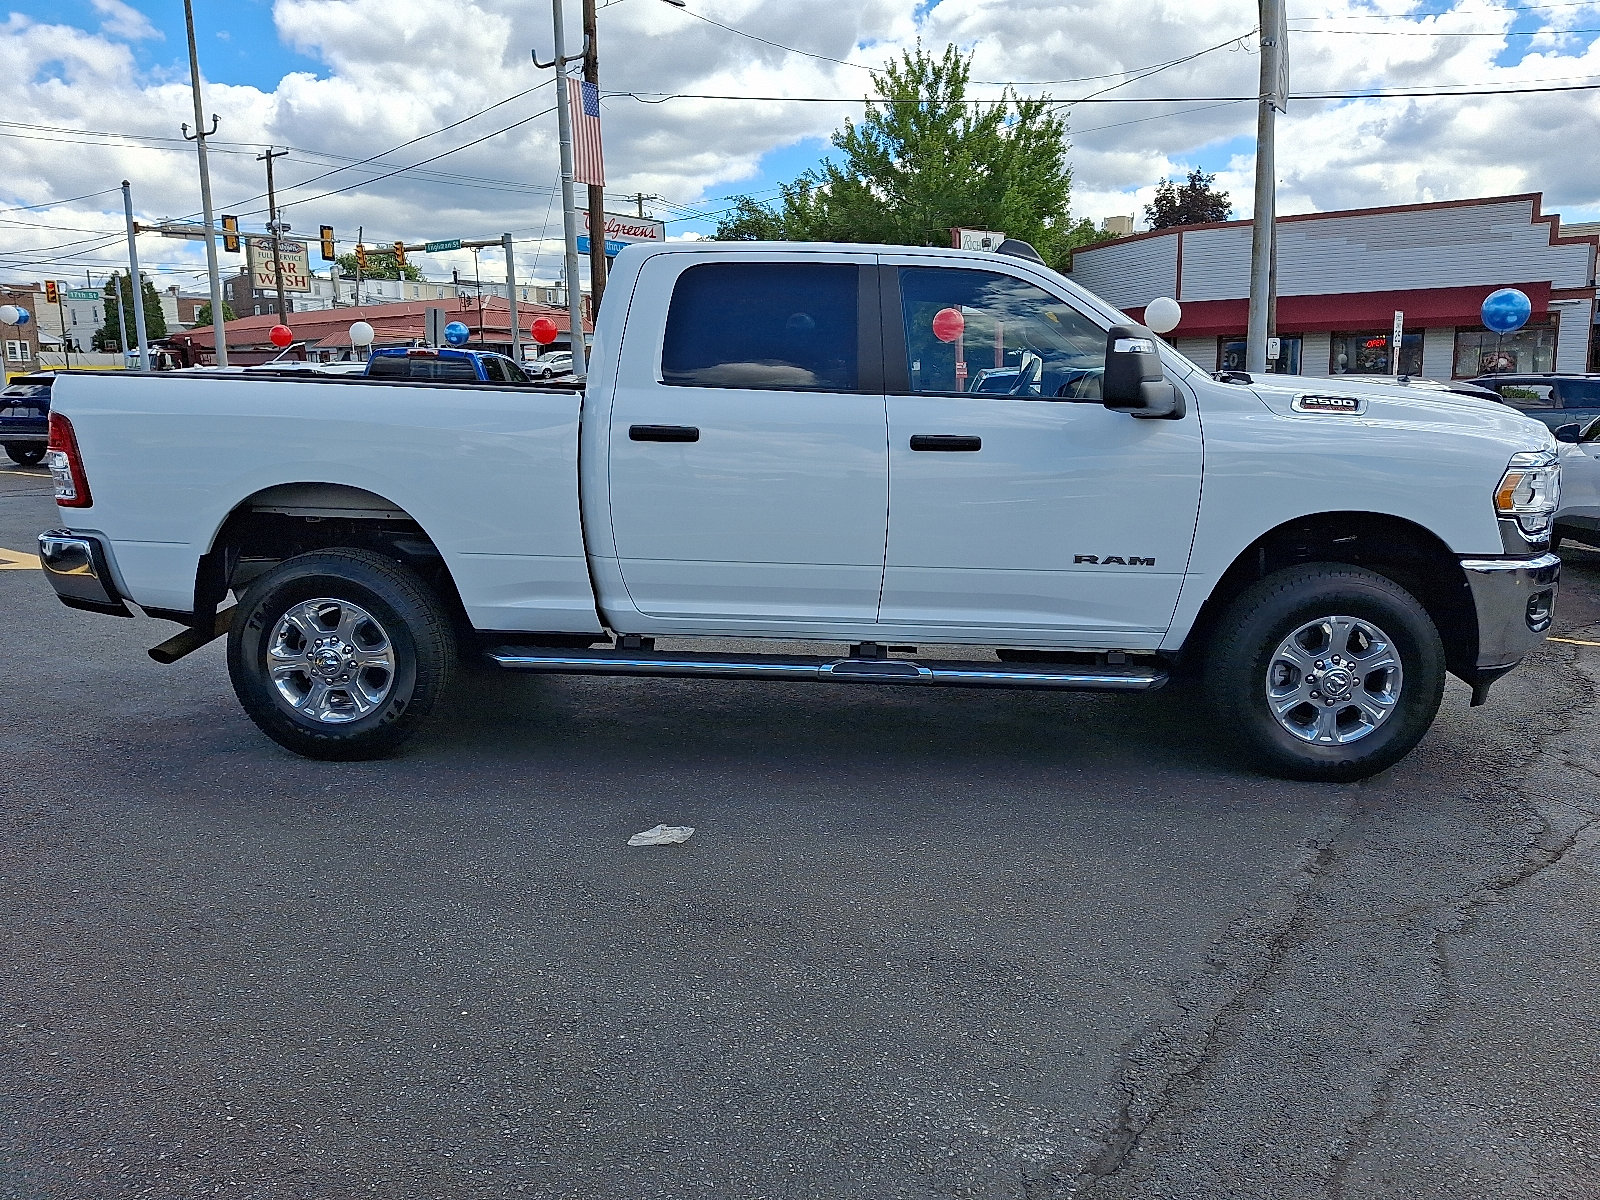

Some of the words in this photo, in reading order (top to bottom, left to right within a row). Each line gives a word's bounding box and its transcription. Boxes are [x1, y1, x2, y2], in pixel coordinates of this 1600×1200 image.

[279, 253, 302, 262] ERVICE
[258, 273, 306, 287] WSH
[1366, 339, 1386, 348] OPEN
[1305, 397, 1355, 406] 2500
[1073, 554, 1156, 566] RAM
